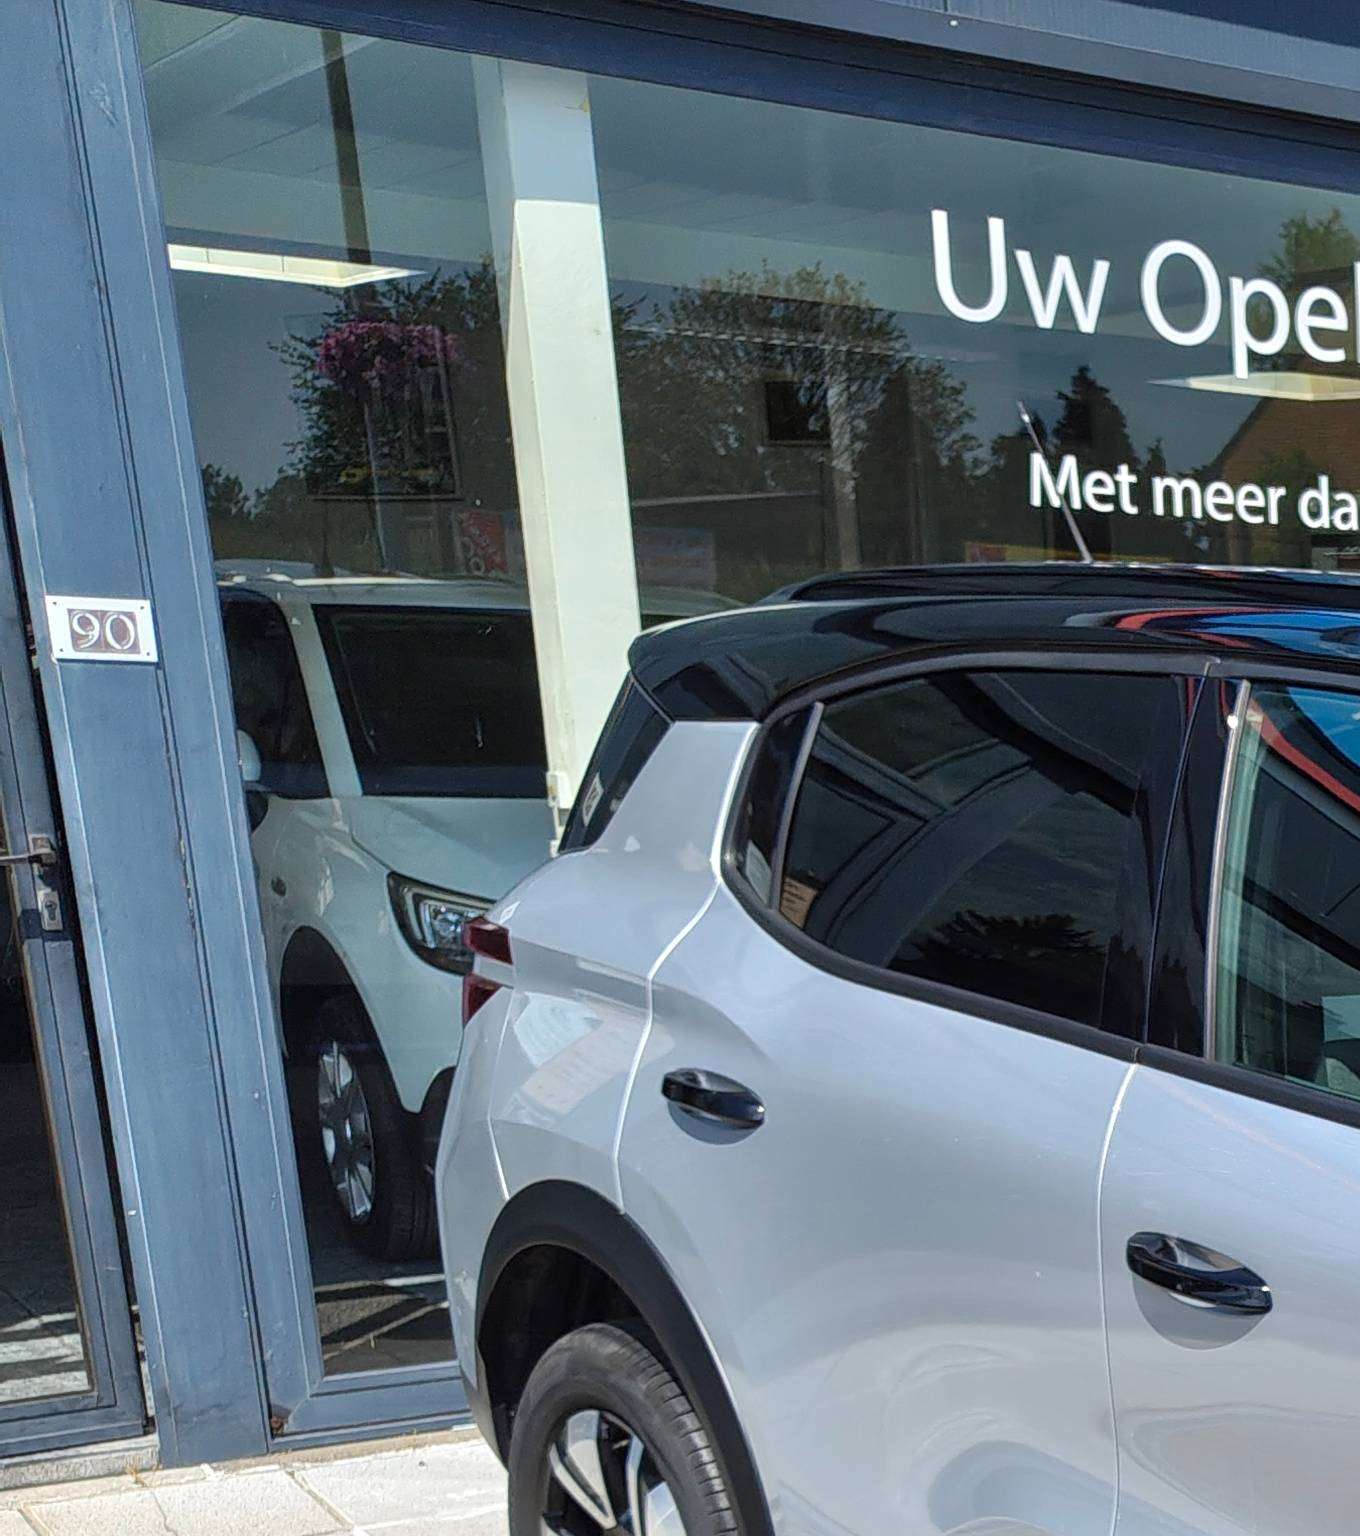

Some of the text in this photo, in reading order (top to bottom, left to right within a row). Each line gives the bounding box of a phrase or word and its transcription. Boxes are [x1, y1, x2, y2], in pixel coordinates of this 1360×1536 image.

[931, 209, 1111, 334] Uw
[1030, 452, 1139, 515] Met
[1152, 476, 1287, 525] meer
[71, 611, 137, 650] 90
